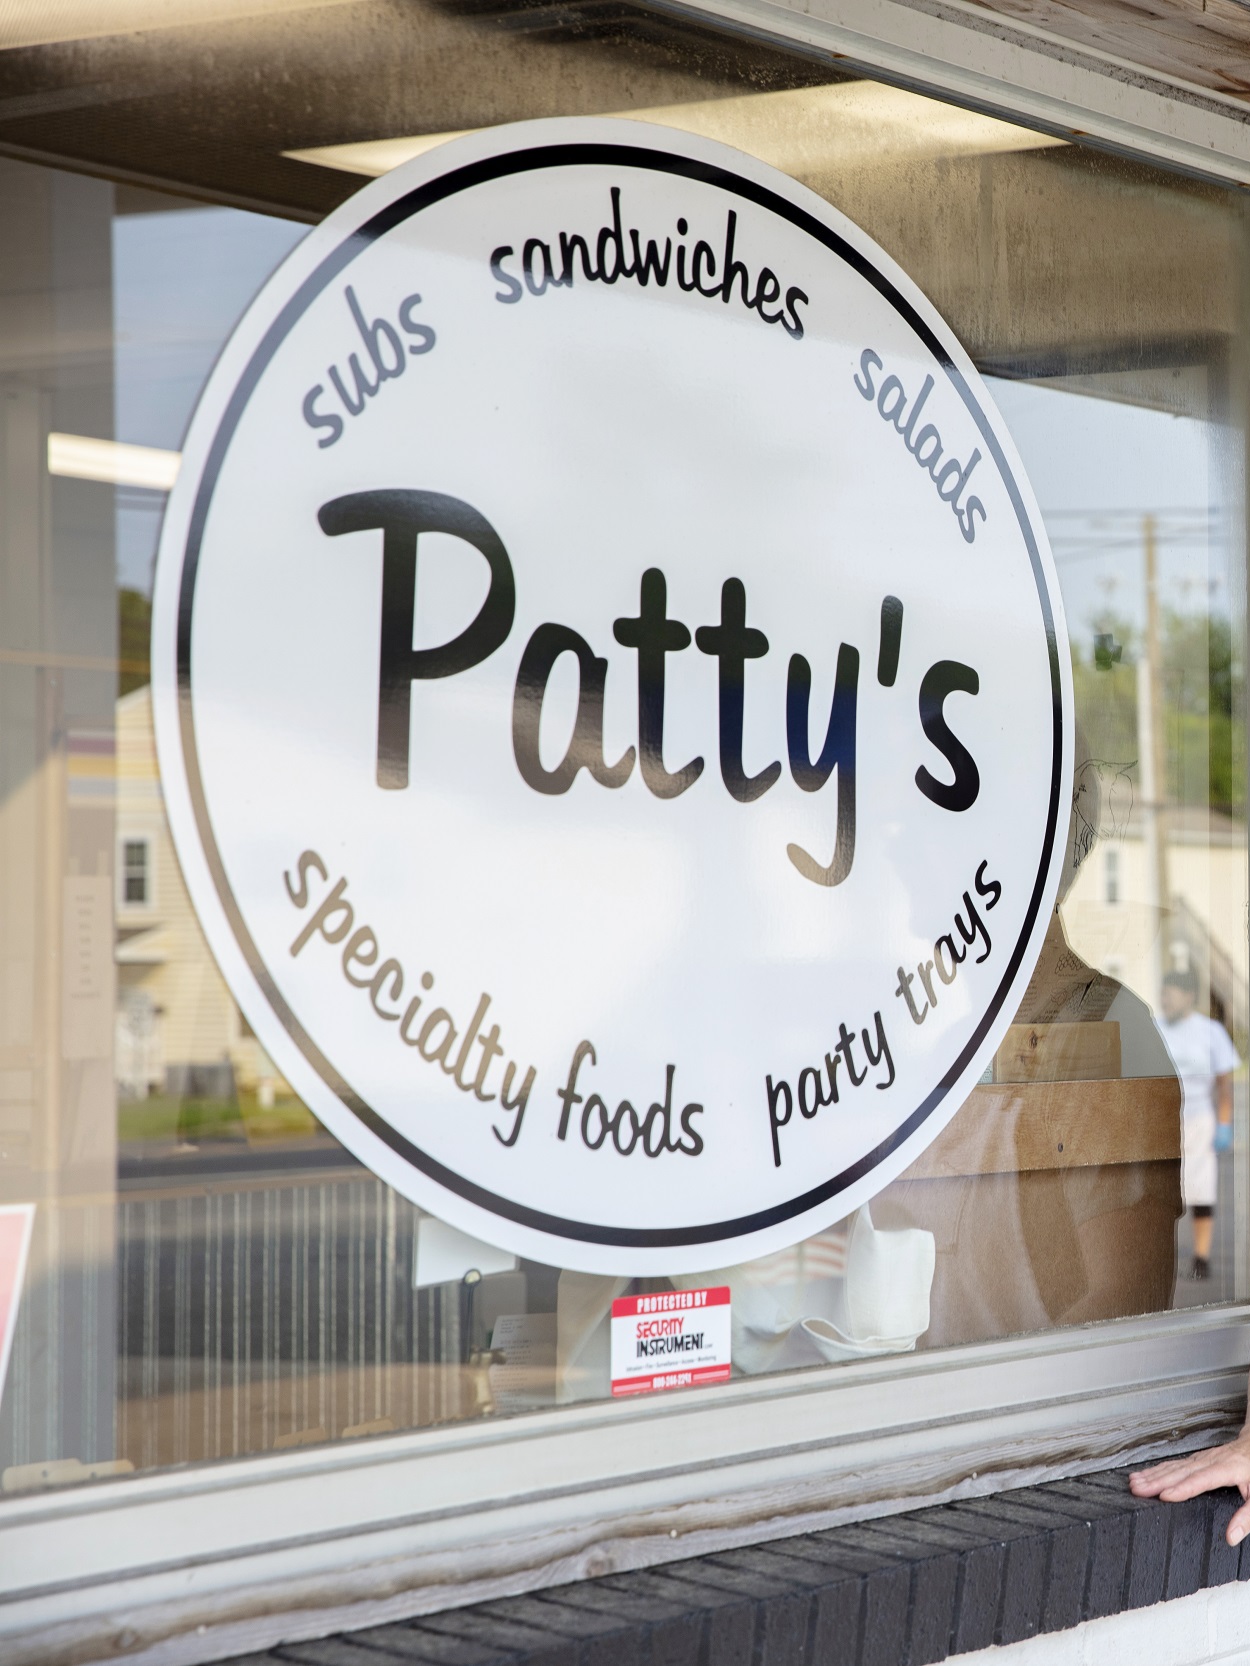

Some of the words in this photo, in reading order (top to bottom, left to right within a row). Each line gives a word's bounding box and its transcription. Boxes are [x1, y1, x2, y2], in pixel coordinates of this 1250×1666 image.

[490, 186, 809, 340] sandwiches
[302, 285, 436, 449] subs
[854, 349, 987, 544] salads
[317, 488, 980, 887] Patty's
[283, 850, 537, 1148] specialty
[557, 1040, 704, 1158] foods
[766, 1011, 896, 1168] party
[895, 859, 1002, 1025] trays
[636, 1318, 684, 1339] SECURITY
[636, 1333, 704, 1358] INSTRUMENT
[637, 1293, 693, 1314] PROTECTED
[694, 1291, 707, 1306] BY
